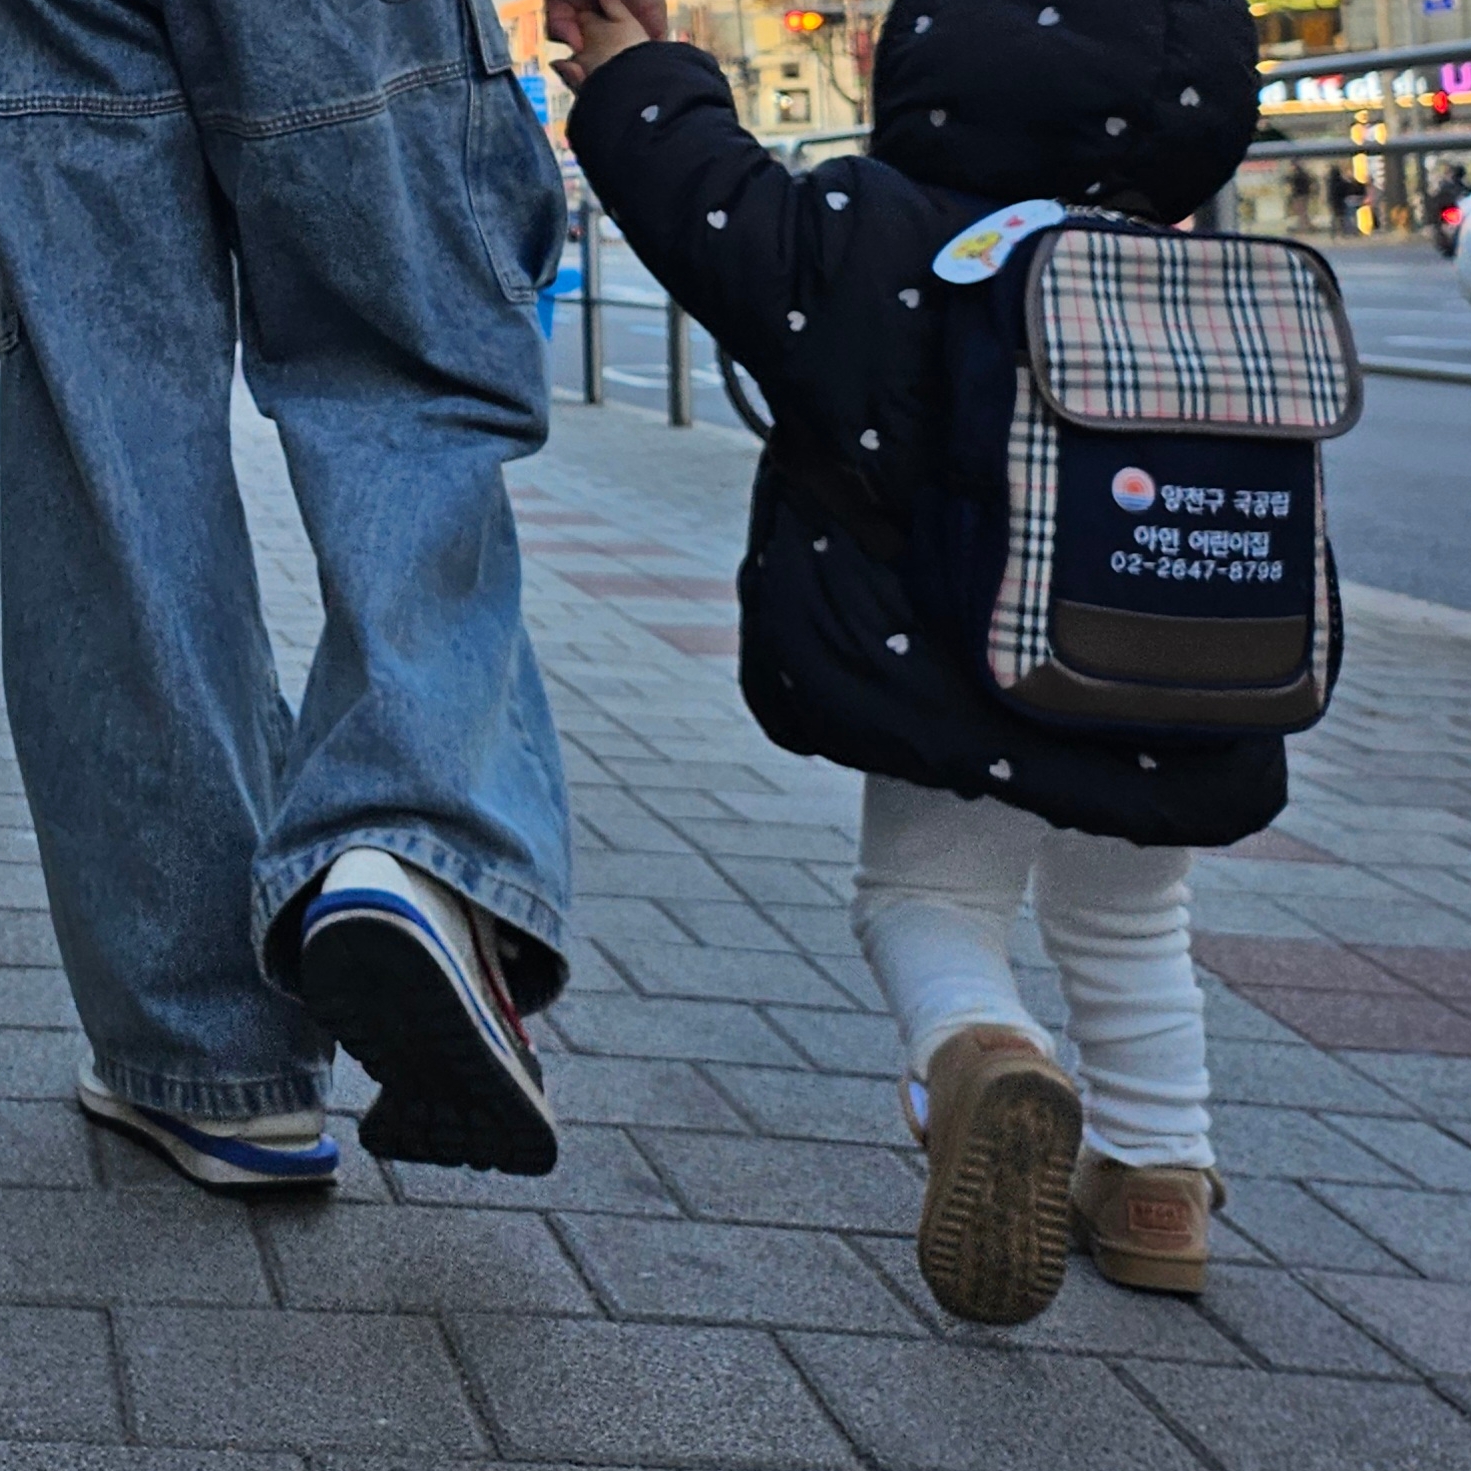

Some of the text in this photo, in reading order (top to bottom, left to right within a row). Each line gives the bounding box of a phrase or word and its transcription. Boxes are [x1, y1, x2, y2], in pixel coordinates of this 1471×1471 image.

[1160, 484, 1291, 518] 양천구 국공립
[1133, 524, 1271, 559] 아인 어린이집
